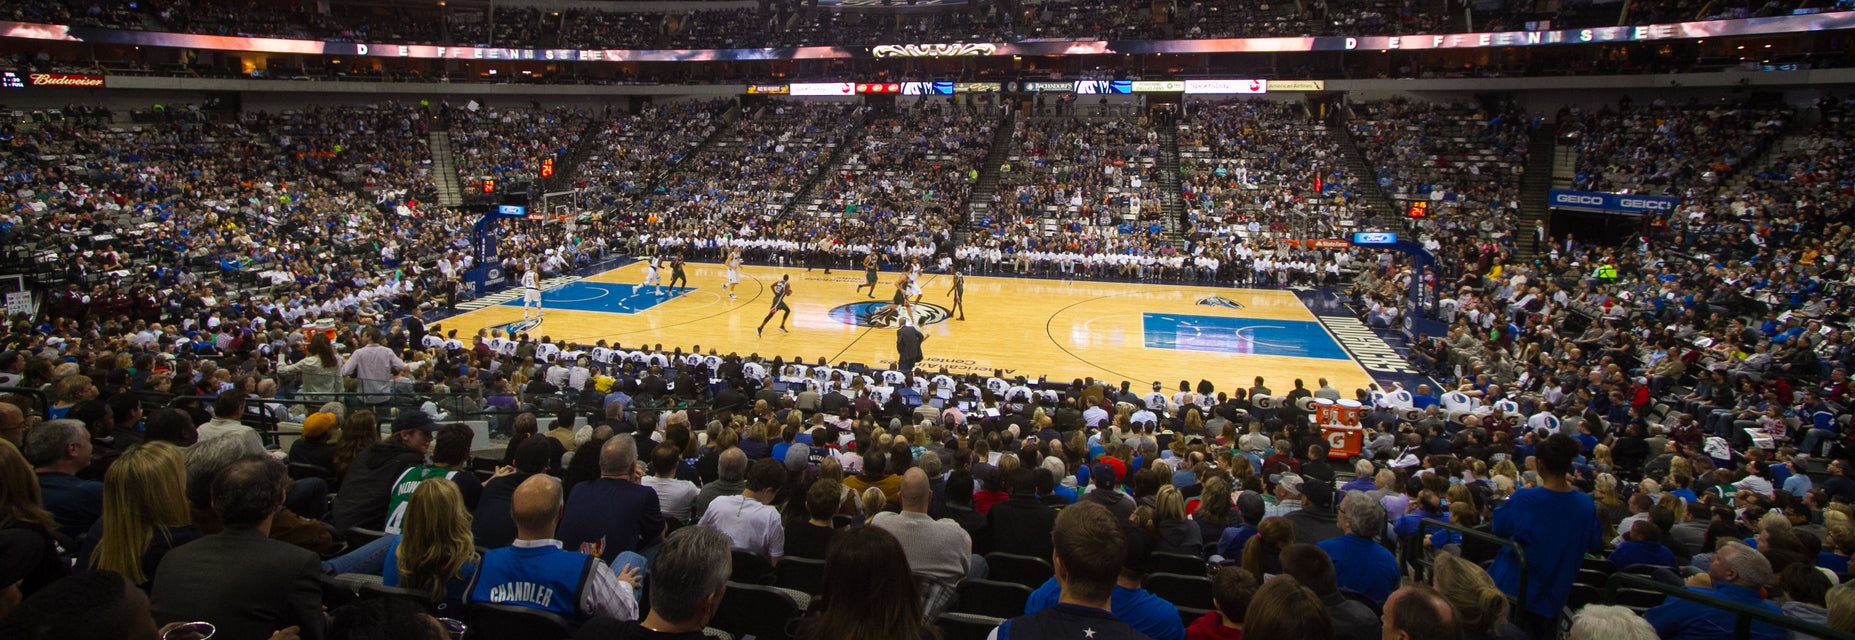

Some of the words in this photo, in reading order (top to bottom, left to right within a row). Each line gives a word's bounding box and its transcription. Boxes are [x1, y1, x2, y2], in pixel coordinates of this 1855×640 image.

[30, 74, 103, 85] Budweiser
[1557, 194, 1604, 205] GEICO
[1620, 199, 1672, 210] GEICO
[1410, 207, 1423, 216] 24
[1328, 432, 1345, 449] G
[490, 581, 553, 607] CHANDLER
